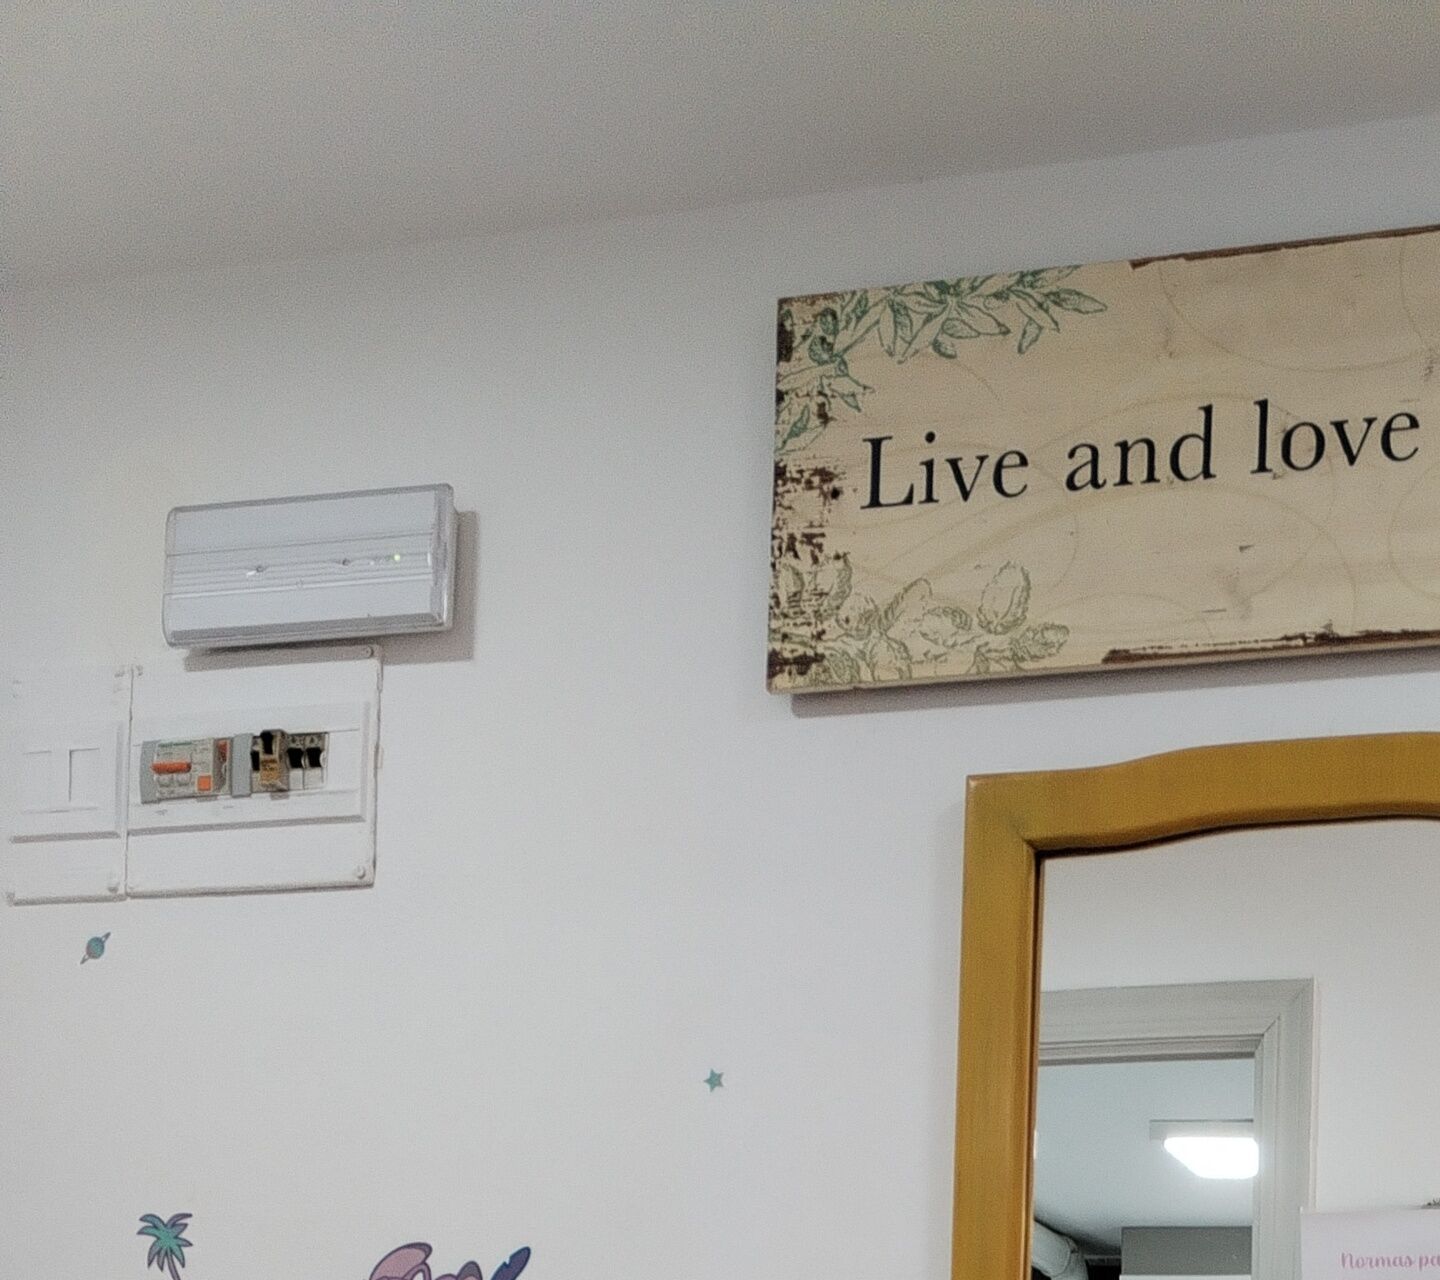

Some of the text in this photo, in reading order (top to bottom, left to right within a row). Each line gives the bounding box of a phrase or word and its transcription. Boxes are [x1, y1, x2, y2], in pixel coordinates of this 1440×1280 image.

[861, 431, 1028, 509] Live
[1064, 404, 1216, 490] and
[1250, 398, 1421, 475] love
[1341, 1252, 1414, 1269] Normas
